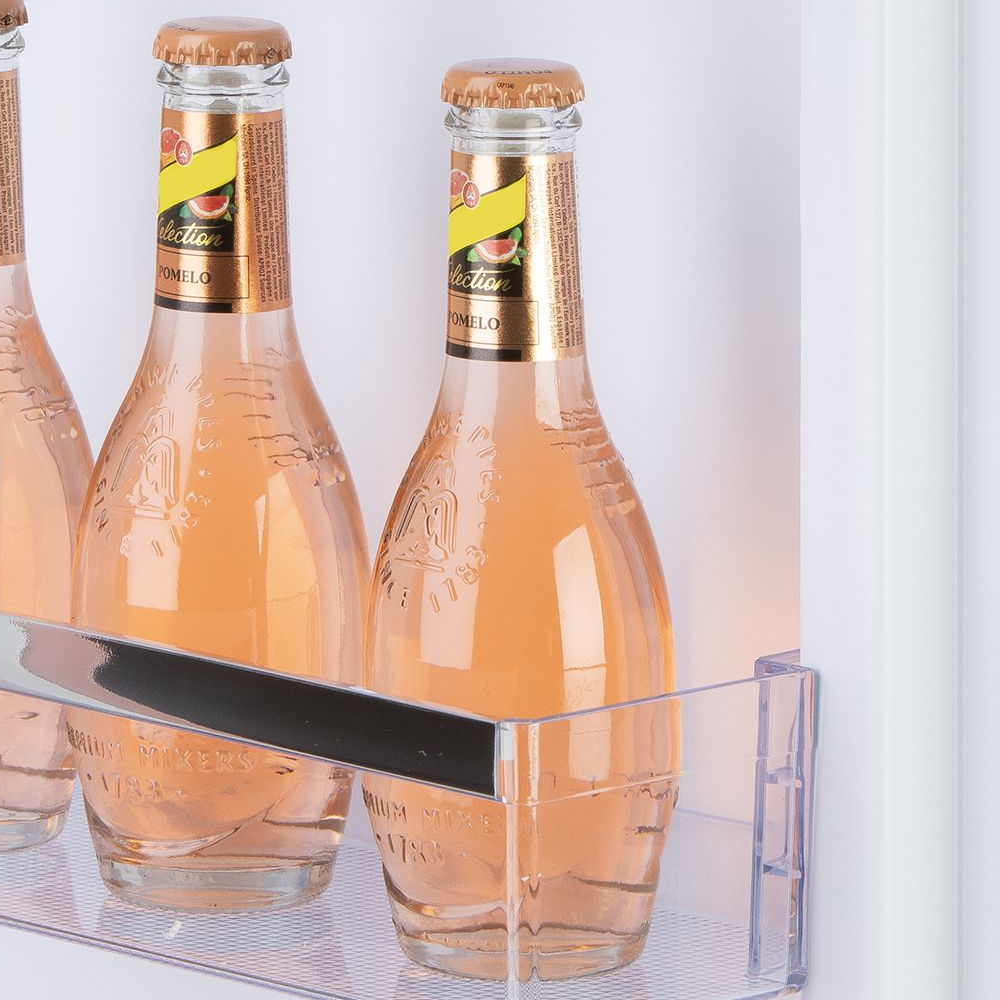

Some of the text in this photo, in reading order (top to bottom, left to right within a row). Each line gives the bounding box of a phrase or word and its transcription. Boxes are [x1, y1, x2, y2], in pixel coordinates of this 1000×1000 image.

[157, 264, 212, 285] POMELO
[138, 744, 256, 774] MIXERS
[101, 772, 164, 803] 1783
[387, 833, 446, 865] 1783
